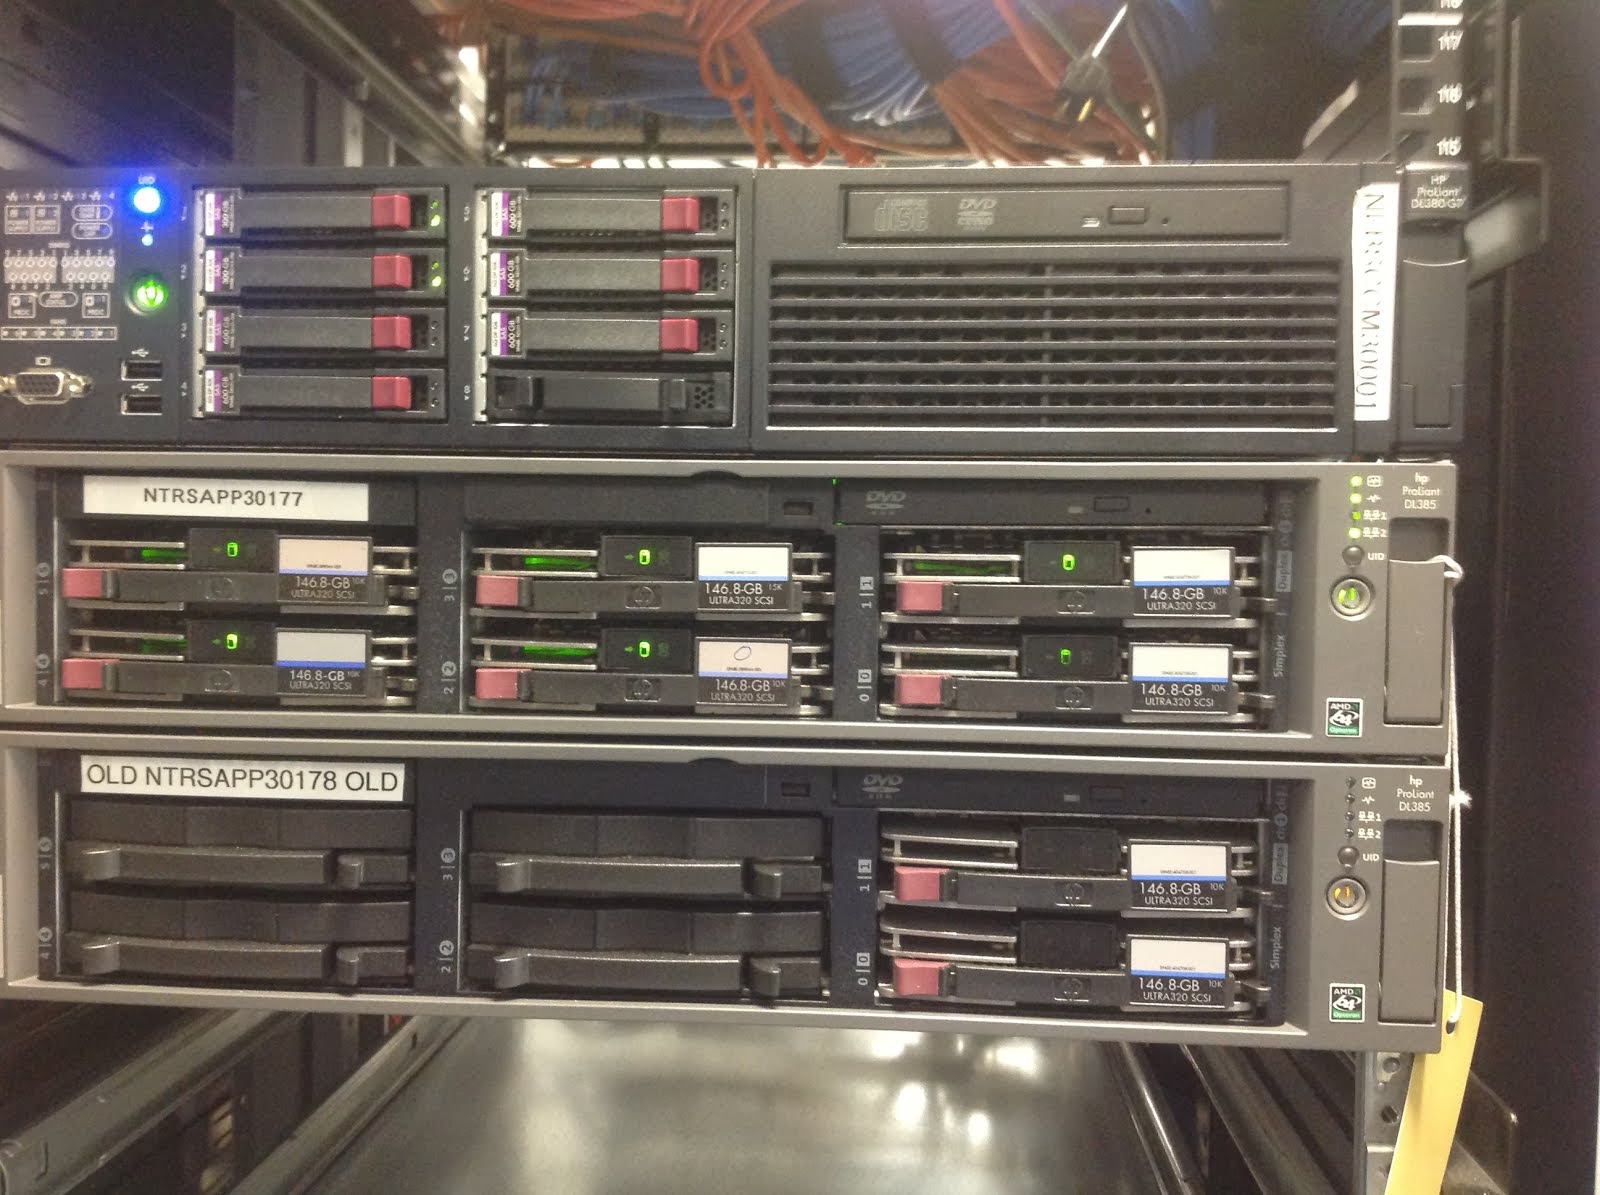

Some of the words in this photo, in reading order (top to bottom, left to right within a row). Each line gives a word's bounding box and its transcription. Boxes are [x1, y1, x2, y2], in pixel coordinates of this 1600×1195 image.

[1430, 175, 1448, 185] HP
[1417, 186, 1461, 197] ProLiant
[959, 198, 998, 210] DVD
[1411, 198, 1446, 209] DL380
[1415, 472, 1429, 485] hp
[866, 490, 907, 502] DVD
[1402, 486, 1441, 496] ProLiant
[144, 487, 303, 507] NTRSAPP30177
[1404, 499, 1437, 509] DL385
[1381, 512, 1387, 520] 1
[1380, 529, 1387, 537] 2
[1367, 552, 1385, 561] UID
[296, 576, 350, 589] 146.8-GB
[705, 582, 763, 595] 146.8-GB
[1143, 587, 1204, 600] 146.8-GB
[709, 596, 752, 605] ULTRA320
[755, 596, 774, 605] SCSI
[1147, 601, 1192, 610] ULTRA320
[1196, 601, 1216, 610] SCSI
[1273, 634, 1286, 678] Simplex
[289, 669, 345, 681] 146.8-GB
[289, 680, 330, 689] ULTRA320
[716, 679, 770, 692] 146.8-GB
[1142, 683, 1202, 696] 146.8-GB
[711, 692, 753, 701] ULTRA320
[756, 693, 775, 702] SCSI
[1145, 697, 1190, 707] ULTRA320
[1194, 698, 1214, 707] SCSI
[87, 764, 137, 785] OLD
[145, 766, 337, 791] NTRSAPP30178
[345, 770, 398, 792] OLD
[863, 774, 904, 786] DVD
[1409, 774, 1423, 788] hp
[1396, 788, 1434, 799] ProLiant
[1399, 801, 1431, 812] DL385
[1376, 813, 1382, 822] 1
[1375, 830, 1381, 839] 2
[1362, 853, 1380, 862] UID
[1140, 882, 1201, 895] 146.8-GB
[1144, 896, 1190, 906] ULTRA320
[1192, 897, 1213, 906] SCSI
[1270, 926, 1283, 968] Simplex
[1139, 977, 1200, 992] 146.8-GB
[1143, 991, 1188, 1002] ULTRA320
[1191, 993, 1211, 1002] SCSI
